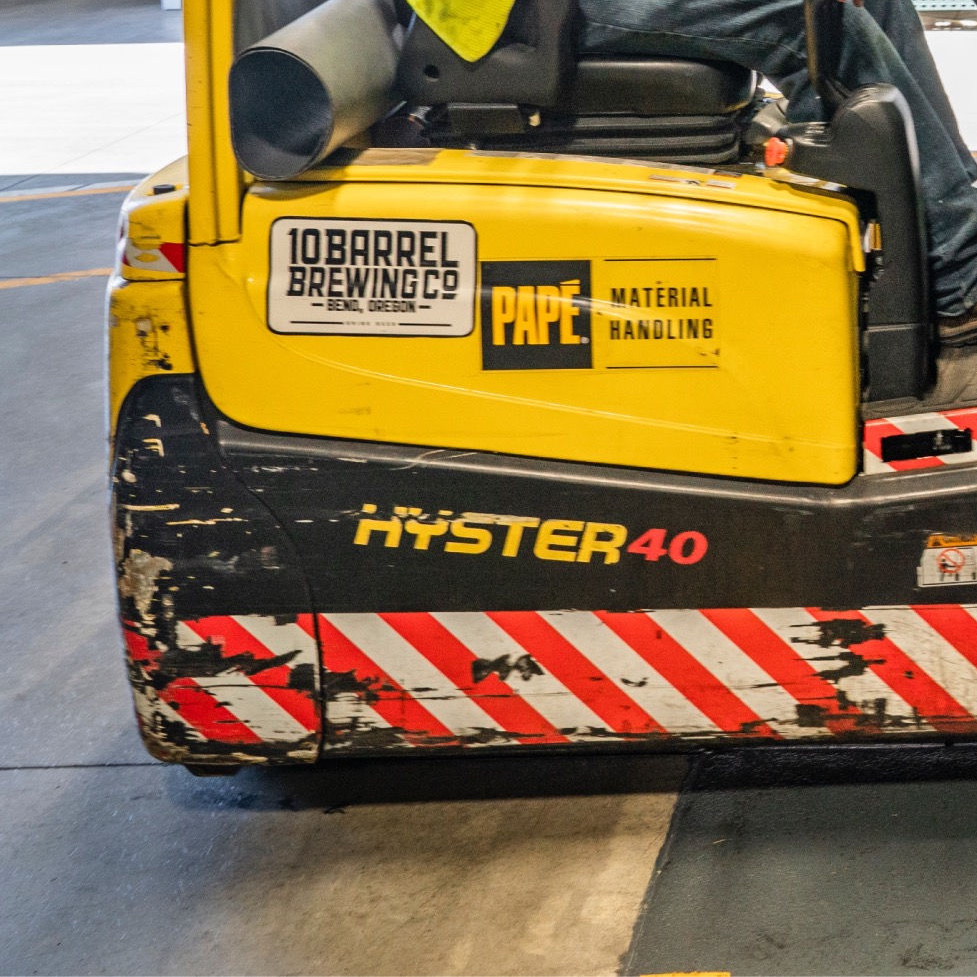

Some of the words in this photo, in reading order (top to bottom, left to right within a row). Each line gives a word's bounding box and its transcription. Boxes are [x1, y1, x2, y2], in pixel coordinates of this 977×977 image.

[368, 300, 416, 313] OREGON
[610, 318, 713, 340] HANDLING
[354, 504, 627, 564] HYSTER
[626, 528, 709, 565] 40
